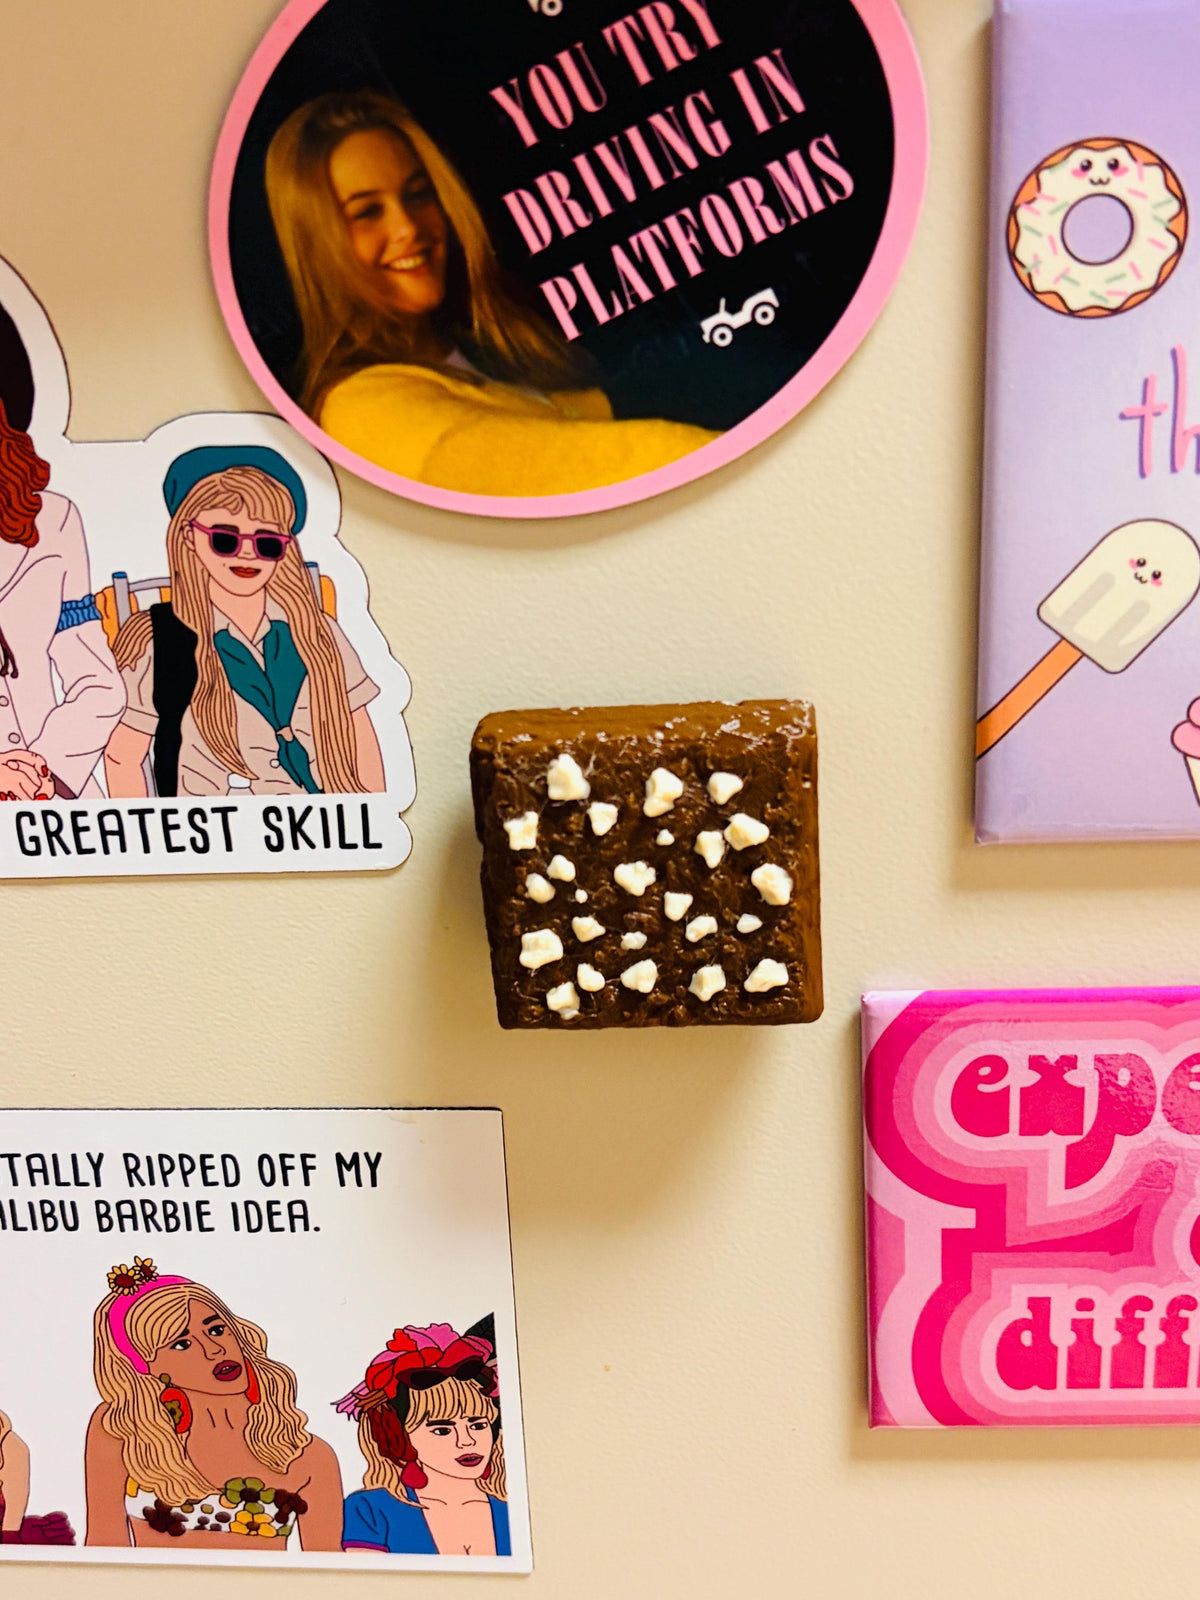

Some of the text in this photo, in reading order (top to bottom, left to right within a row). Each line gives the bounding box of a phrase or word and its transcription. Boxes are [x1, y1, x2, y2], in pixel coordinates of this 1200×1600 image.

[489, 0, 723, 148] YOU TRY
[502, 48, 806, 256] DRIVING IN
[539, 133, 854, 342] PLATFORMS
[1118, 343, 1200, 480] th
[15, 803, 383, 857] GREATEST SKILL
[0, 1151, 382, 1188] TALLY RIPPED OFF MY
[0, 1199, 321, 1234] LIBU BARBIE IDEA.
[996, 1294, 1200, 1390] diff
